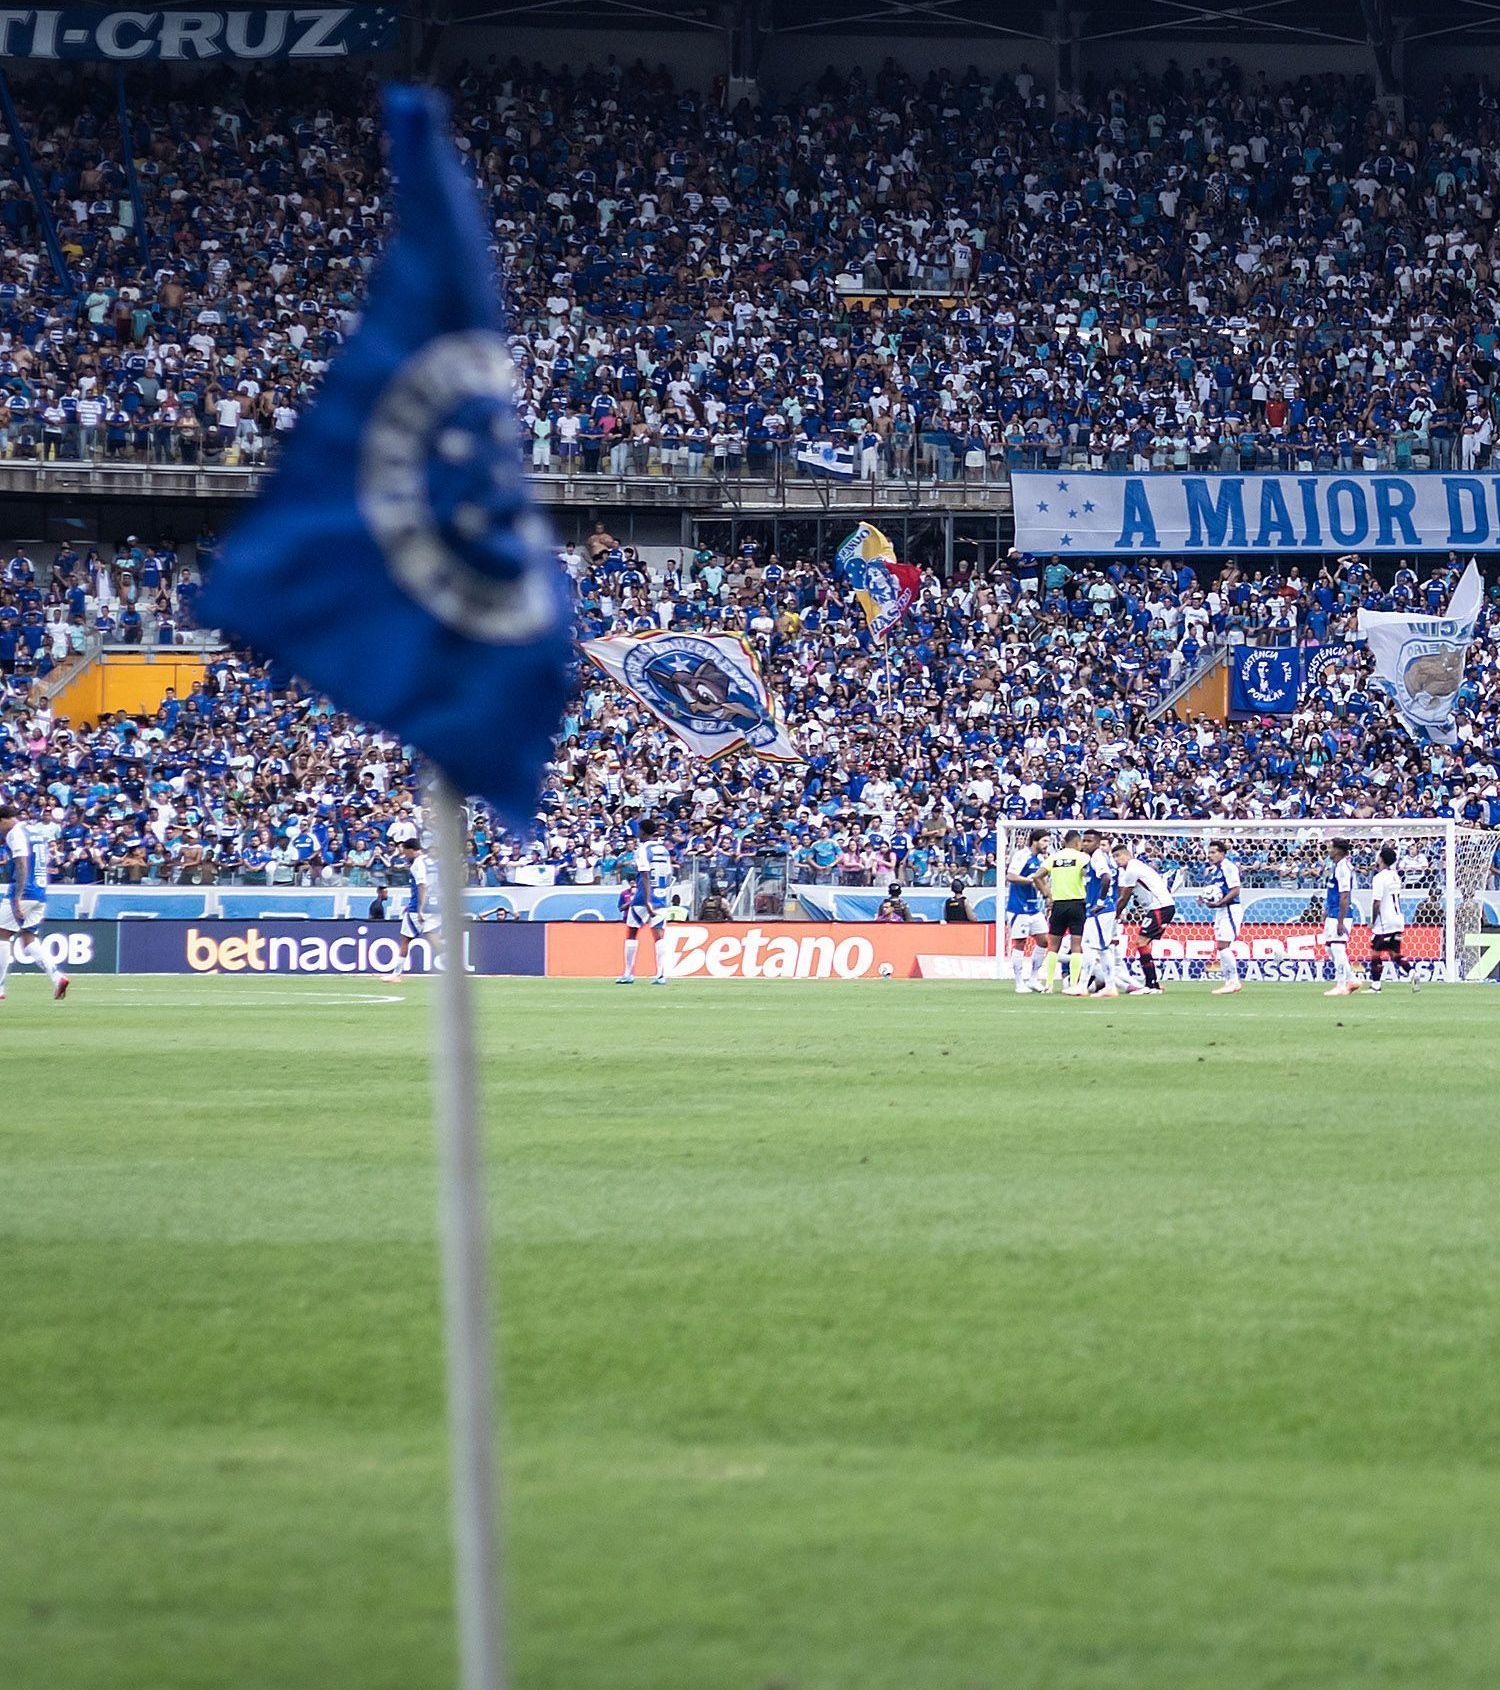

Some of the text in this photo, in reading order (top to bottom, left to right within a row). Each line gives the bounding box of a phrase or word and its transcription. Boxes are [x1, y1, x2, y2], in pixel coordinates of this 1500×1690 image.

[1115, 479, 1161, 548] A
[1182, 477, 1421, 548] MAIOR
[187, 926, 475, 972] betnacionl
[664, 926, 873, 978] Betano
